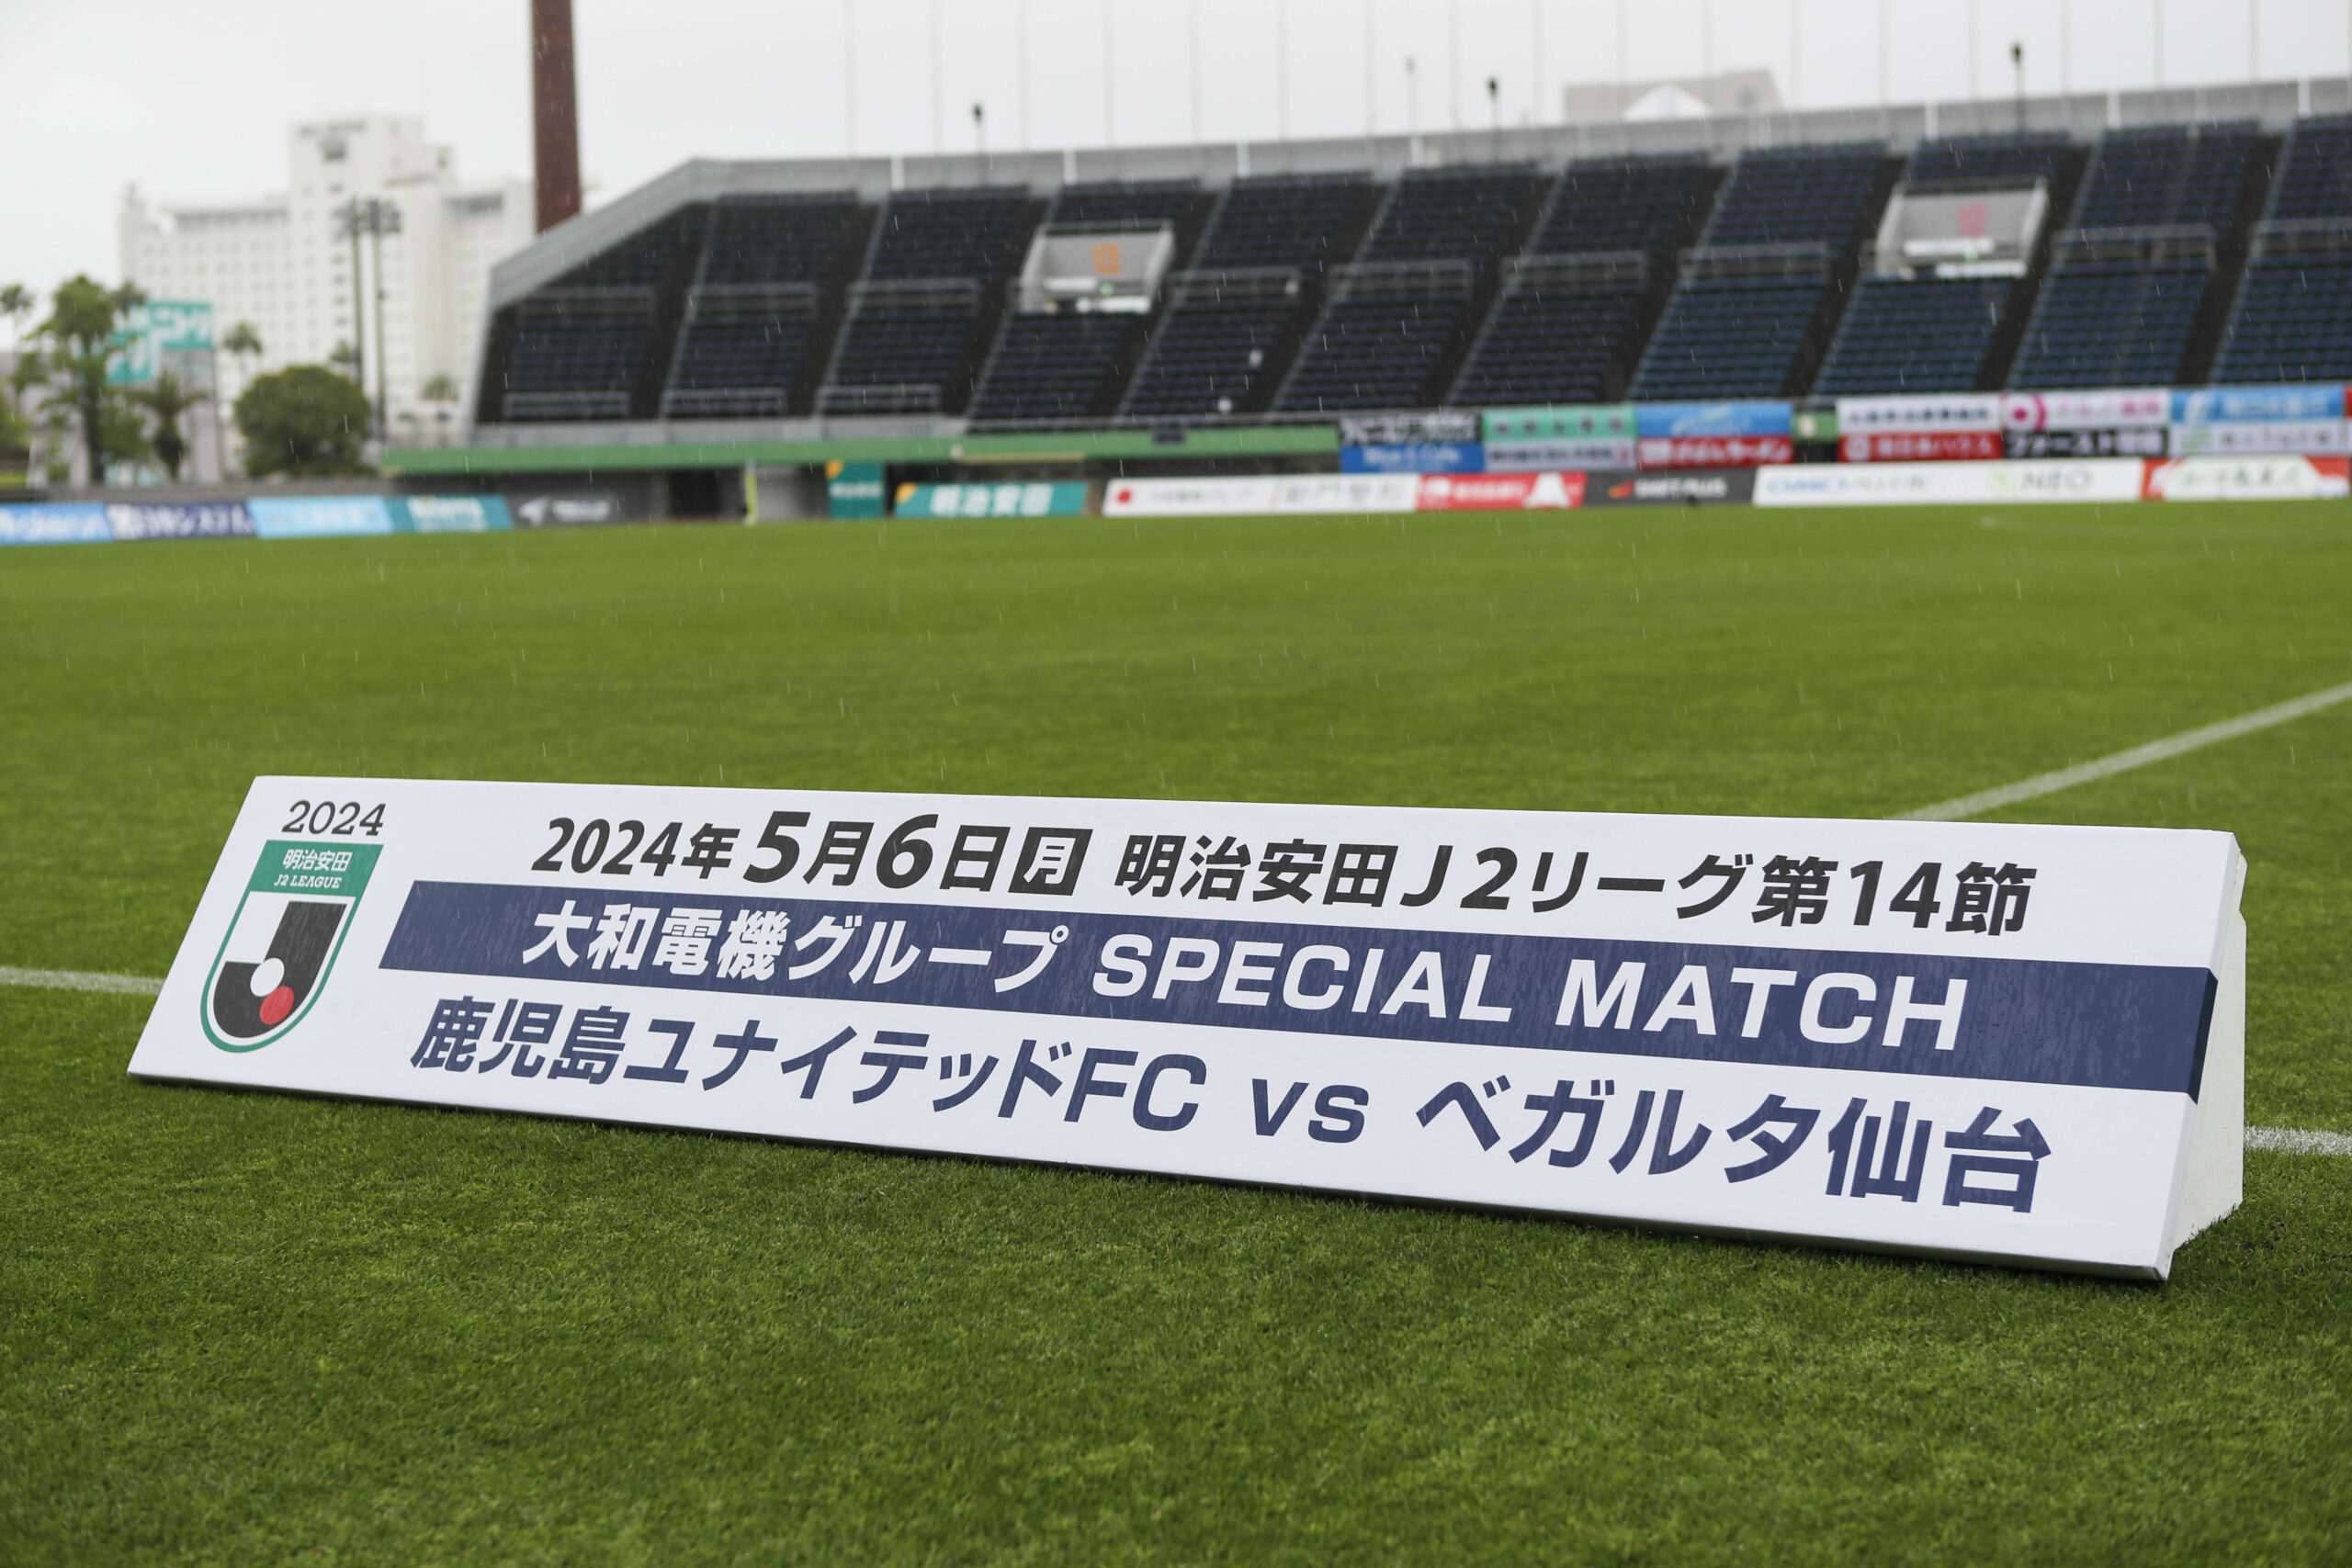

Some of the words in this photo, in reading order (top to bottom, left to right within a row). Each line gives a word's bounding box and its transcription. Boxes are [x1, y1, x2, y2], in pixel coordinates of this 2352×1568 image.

[281, 800, 386, 836] 2024
[282, 849, 353, 872] 明治安田
[274, 874, 288, 887] J2
[289, 875, 342, 888] LEAGUE
[522, 899, 1070, 993] 大和電機グループ
[1091, 933, 1513, 1023] SPECIAL
[1555, 958, 1969, 1051] MATCH
[410, 995, 1207, 1132] 鹿児島ユナイテッドFC
[1415, 1074, 2052, 1213] ベガルタ仙台
